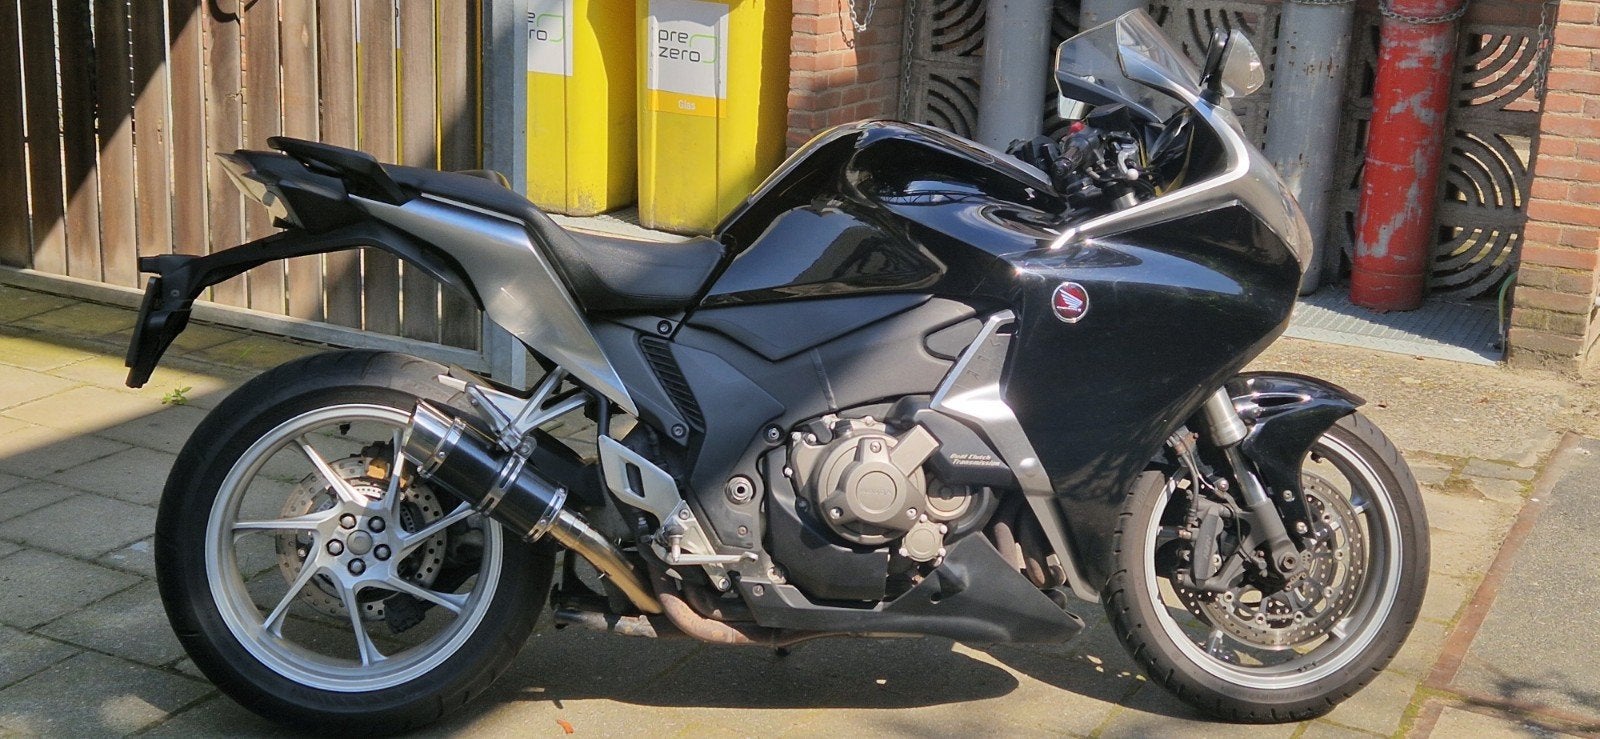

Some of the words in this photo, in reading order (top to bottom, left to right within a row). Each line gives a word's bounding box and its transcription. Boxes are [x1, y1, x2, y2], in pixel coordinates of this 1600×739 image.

[528, 29, 547, 41] ro
[658, 29, 689, 44] pre
[658, 45, 701, 62] zero
[678, 99, 697, 110] Glas
